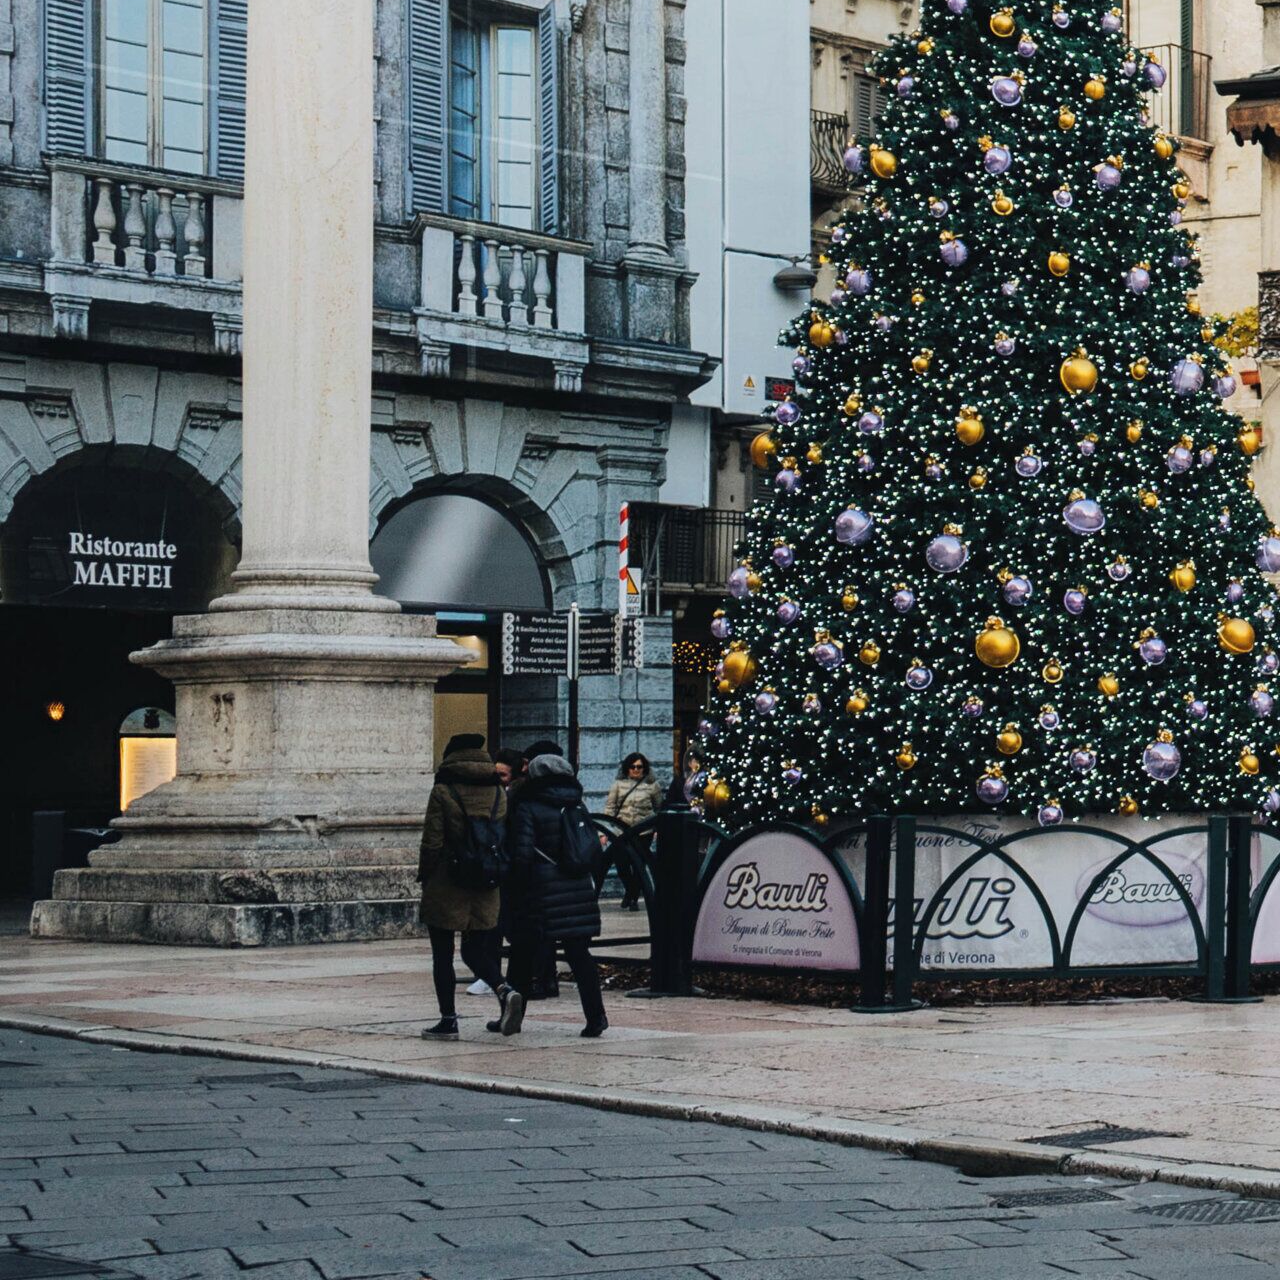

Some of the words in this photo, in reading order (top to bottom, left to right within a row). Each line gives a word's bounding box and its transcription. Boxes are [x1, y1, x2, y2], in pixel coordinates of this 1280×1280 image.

[69, 532, 177, 559] Ristorante
[73, 561, 173, 589] MAFFEI
[723, 862, 829, 913] Bauli
[721, 915, 758, 942] Auguri
[760, 920, 769, 935] di
[771, 918, 808, 939] Buone
[809, 919, 836, 940] Feste
[768, 947, 794, 957] Comune
[794, 947, 801, 957] di
[801, 948, 823, 958] Verona
[934, 952, 945, 963] di
[948, 952, 995, 963] Verona
